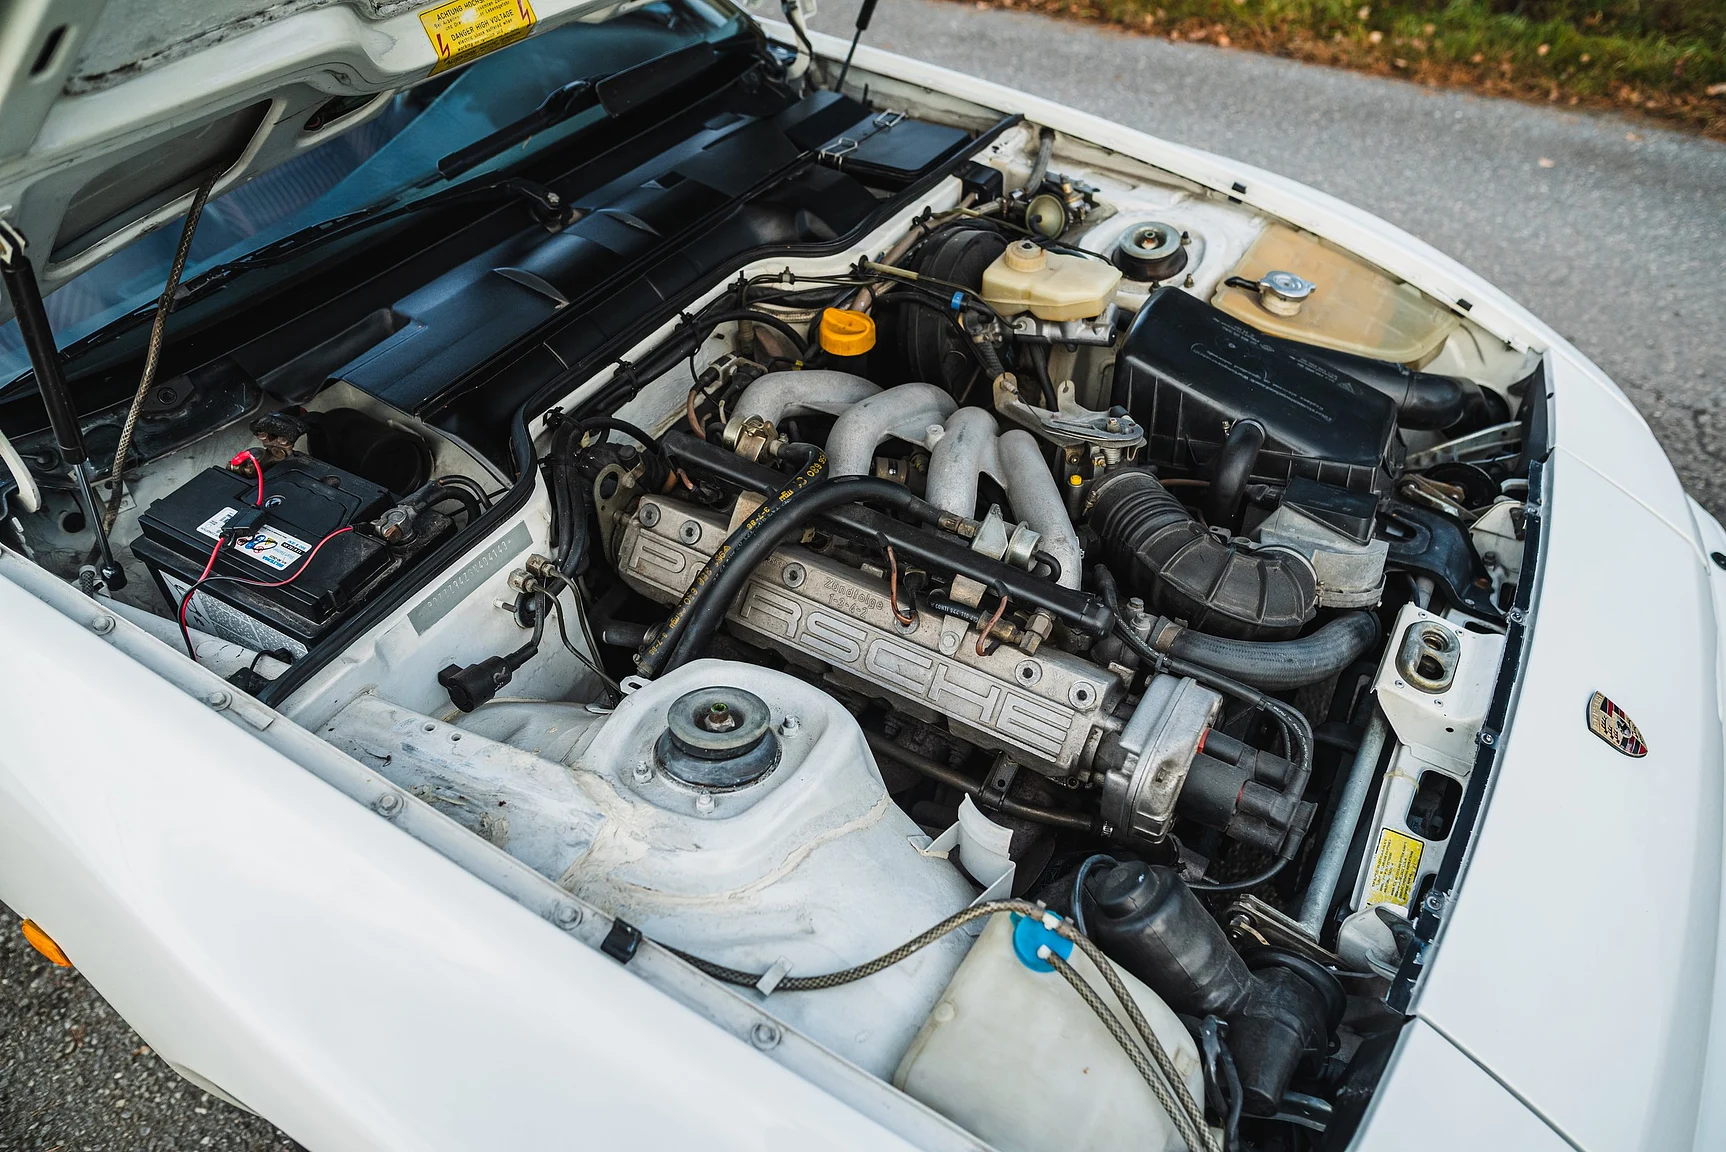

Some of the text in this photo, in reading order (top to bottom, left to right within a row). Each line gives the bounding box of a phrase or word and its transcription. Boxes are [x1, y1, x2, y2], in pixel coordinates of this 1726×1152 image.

[437, 5, 463, 21] ACHTUNG
[450, 27, 475, 41] DANGER
[475, 21, 489, 31] HIGH
[490, 9, 514, 24] VOLTAGE
[828, 594, 868, 619] 1-3-4-2
[632, 535, 1073, 763] PRSCHE
